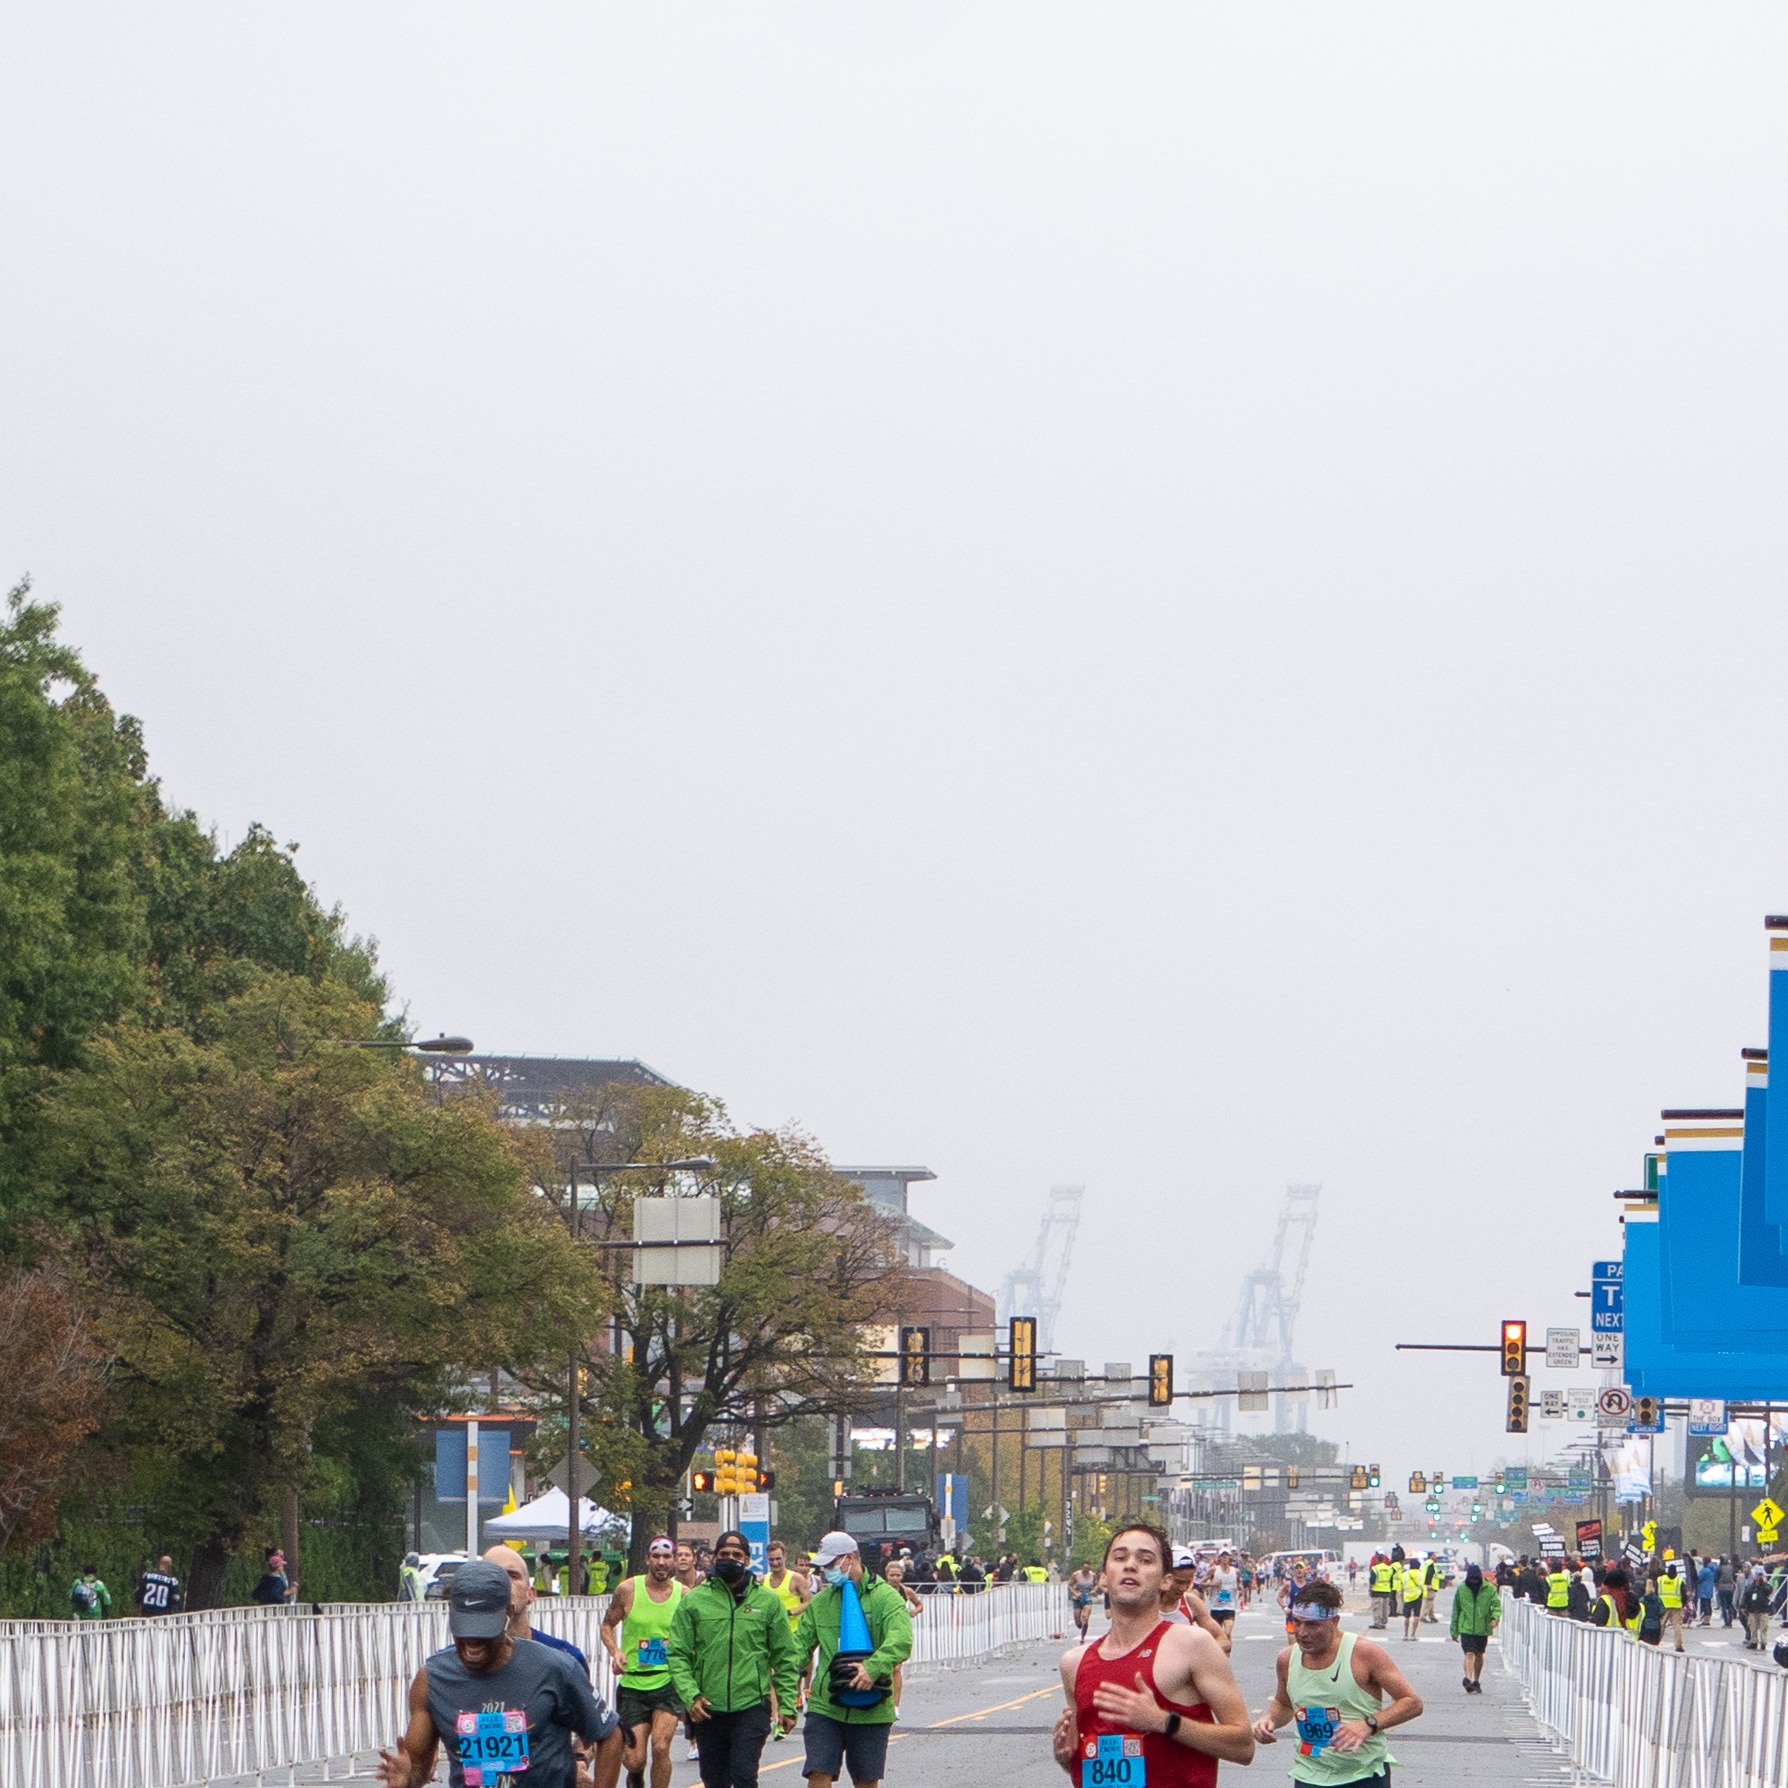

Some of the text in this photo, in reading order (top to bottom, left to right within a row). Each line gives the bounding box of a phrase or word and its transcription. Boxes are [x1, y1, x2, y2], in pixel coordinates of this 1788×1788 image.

[1596, 1343, 1619, 1352] WAY
[1597, 1334, 1619, 1342] ONE
[143, 1582, 169, 1607] 20
[1304, 1722, 1334, 1739] 969
[461, 1735, 525, 1759] 21921
[1092, 1758, 1131, 1784] 840
